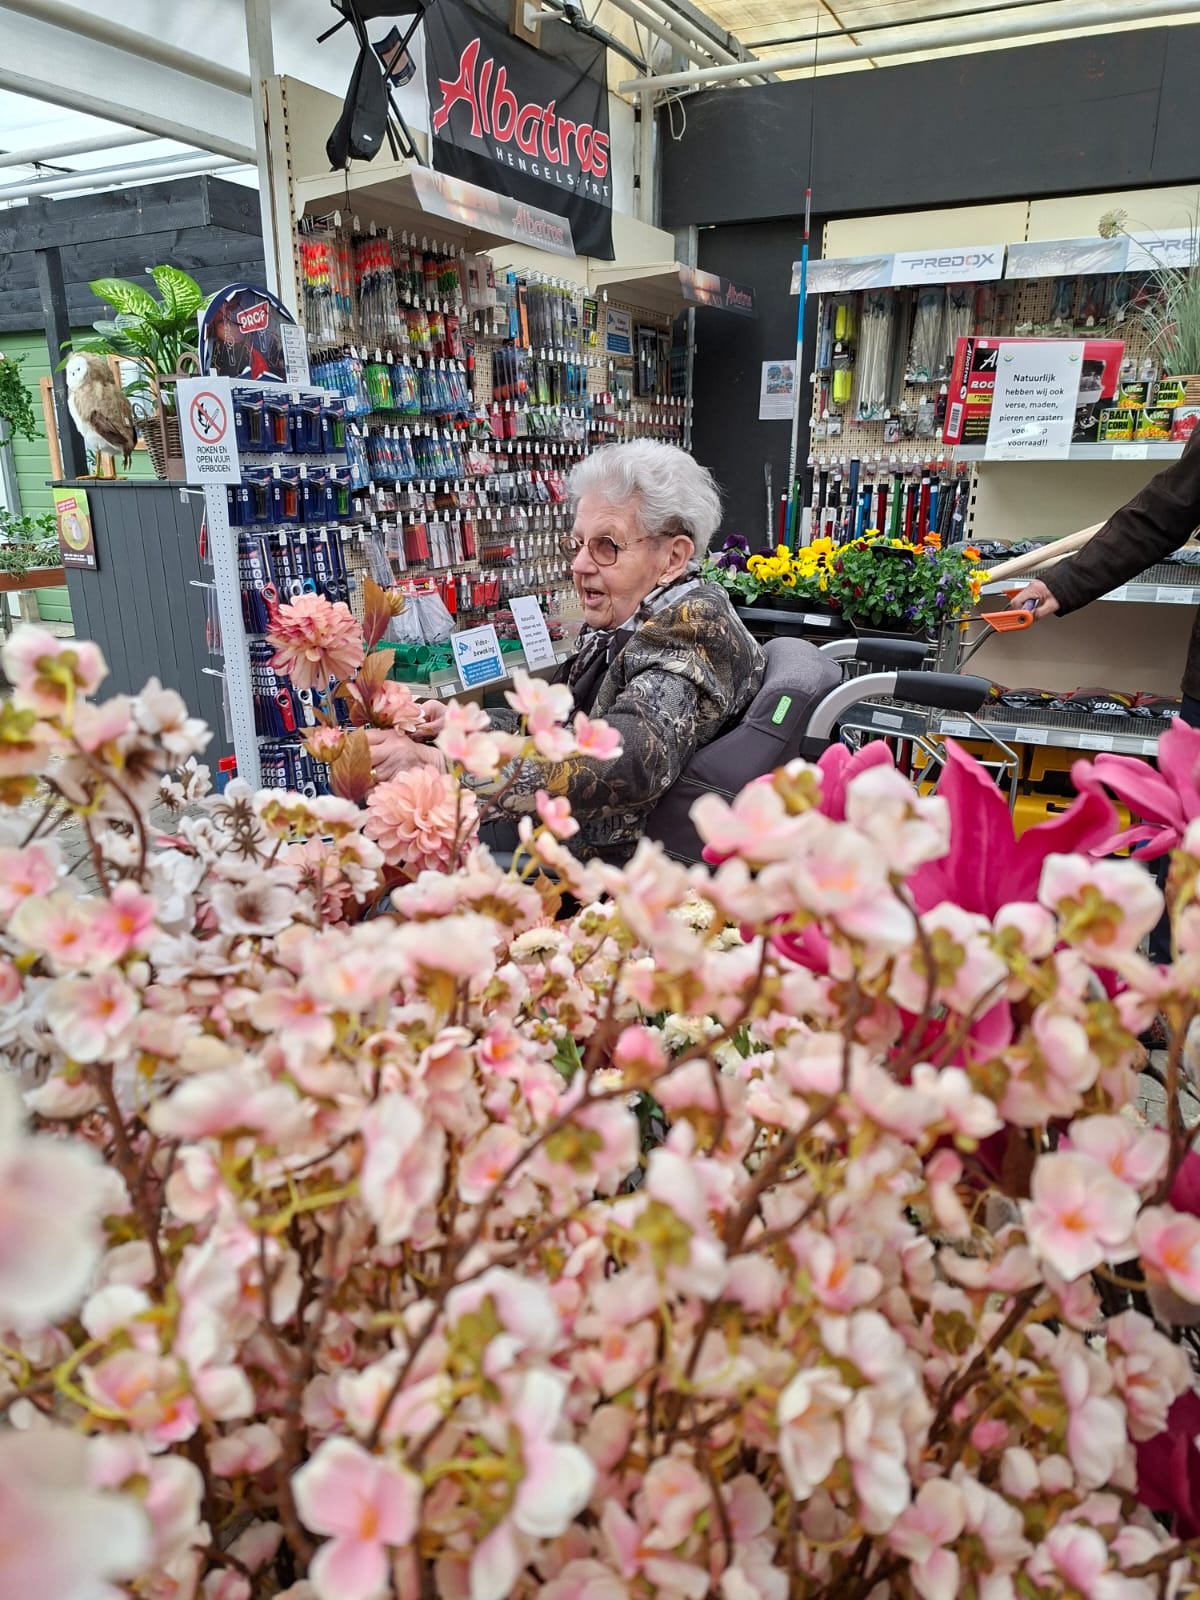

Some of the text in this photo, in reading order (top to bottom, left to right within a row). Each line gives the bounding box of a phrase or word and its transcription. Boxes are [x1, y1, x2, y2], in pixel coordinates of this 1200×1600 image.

[433, 37, 610, 177] Albatros
[512, 206, 564, 242] Albatros
[901, 252, 995, 270] PREDOX
[240, 309, 266, 330] PROF
[1013, 373, 1056, 384] Natuurlijk
[1159, 381, 1179, 391] BAIT
[1005, 387, 1064, 398] hebben wij ook
[1158, 391, 1179, 400] CORN
[1004, 401, 1059, 410] verse, maden,
[999, 414, 1024, 423] pieren
[1036, 414, 1064, 422] casters
[1108, 410, 1129, 420] BAIT
[1107, 421, 1129, 430] CORN
[1007, 439, 1048, 447] voorraad!!
[196, 445, 228, 455] ROKEN EN
[195, 454, 231, 464] OPEN VUUR
[198, 463, 231, 473] VERBODEN
